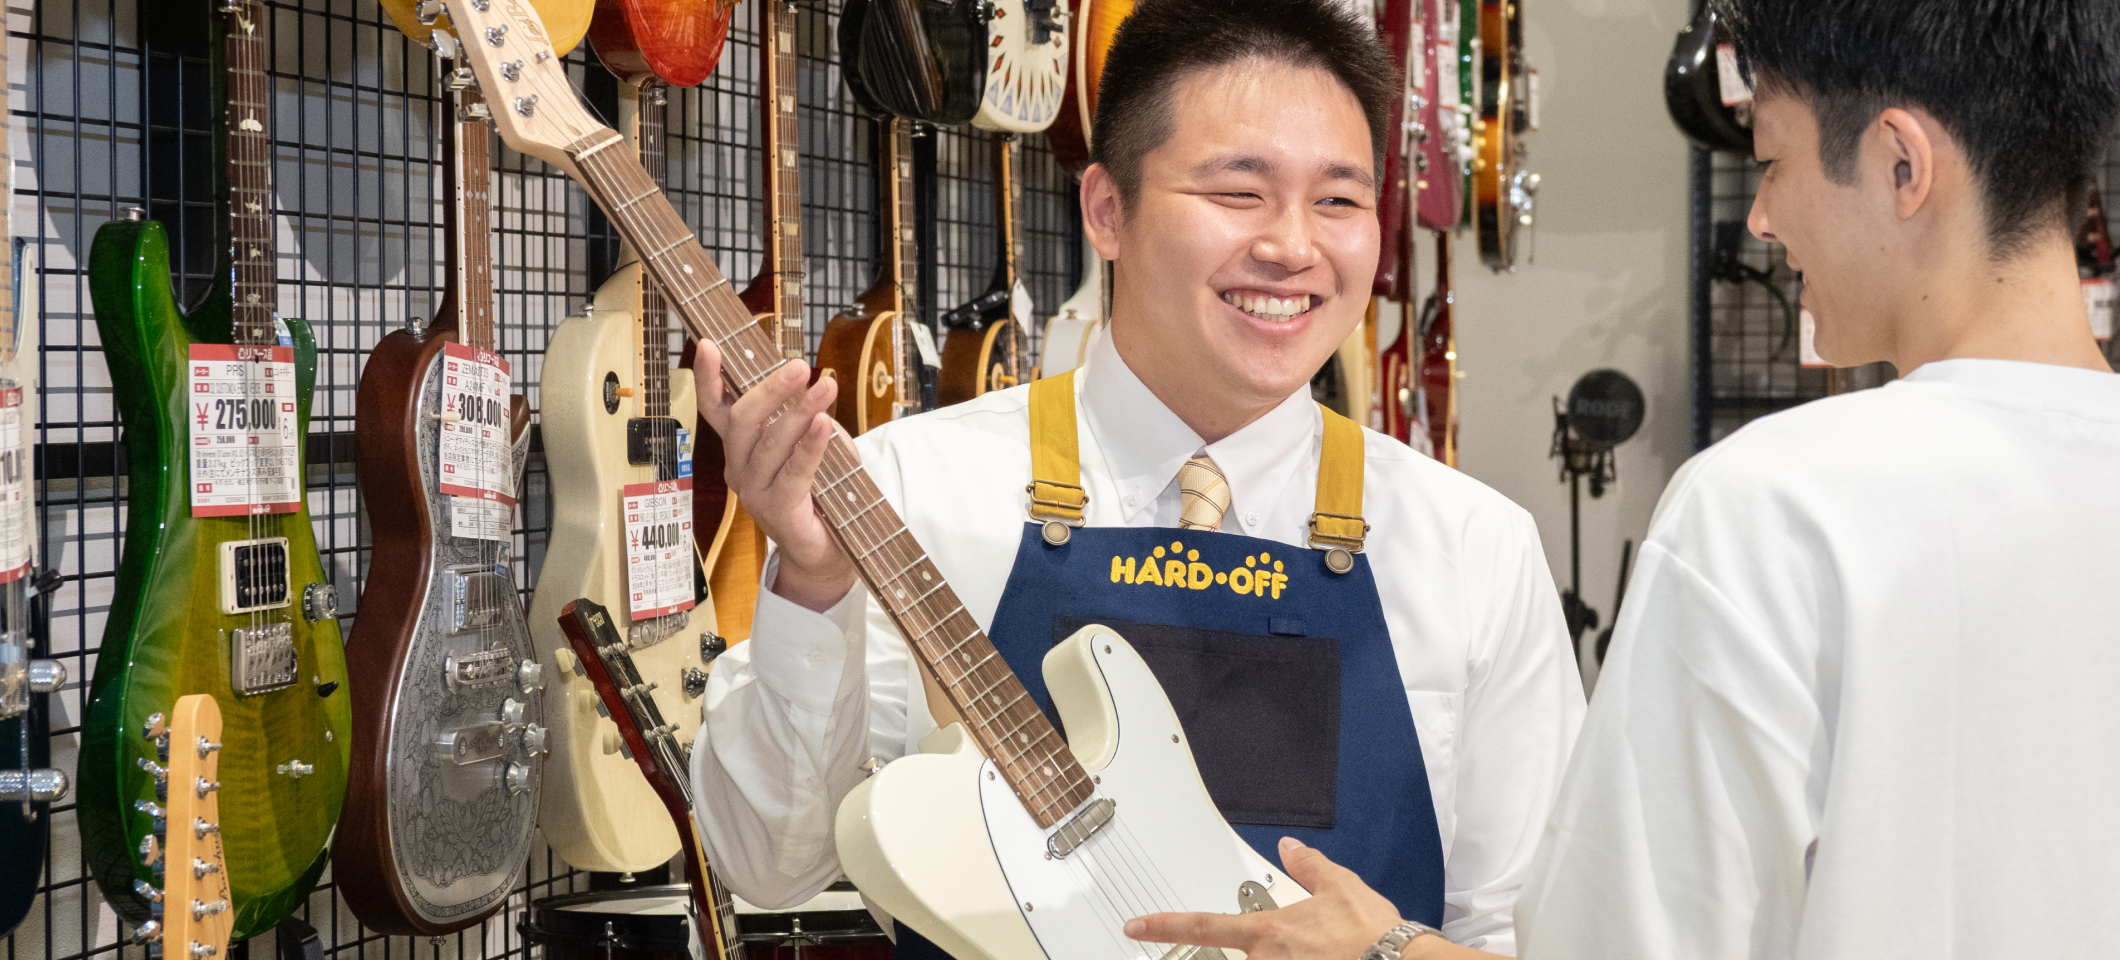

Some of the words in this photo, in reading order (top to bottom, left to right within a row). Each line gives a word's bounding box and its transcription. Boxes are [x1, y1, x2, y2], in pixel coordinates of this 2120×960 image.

[226, 364, 244, 377] PRS
[215, 398, 276, 432] 275,000
[458, 392, 502, 429] 308,000
[644, 496, 667, 509] GIBSON
[642, 521, 680, 550] 440,000
